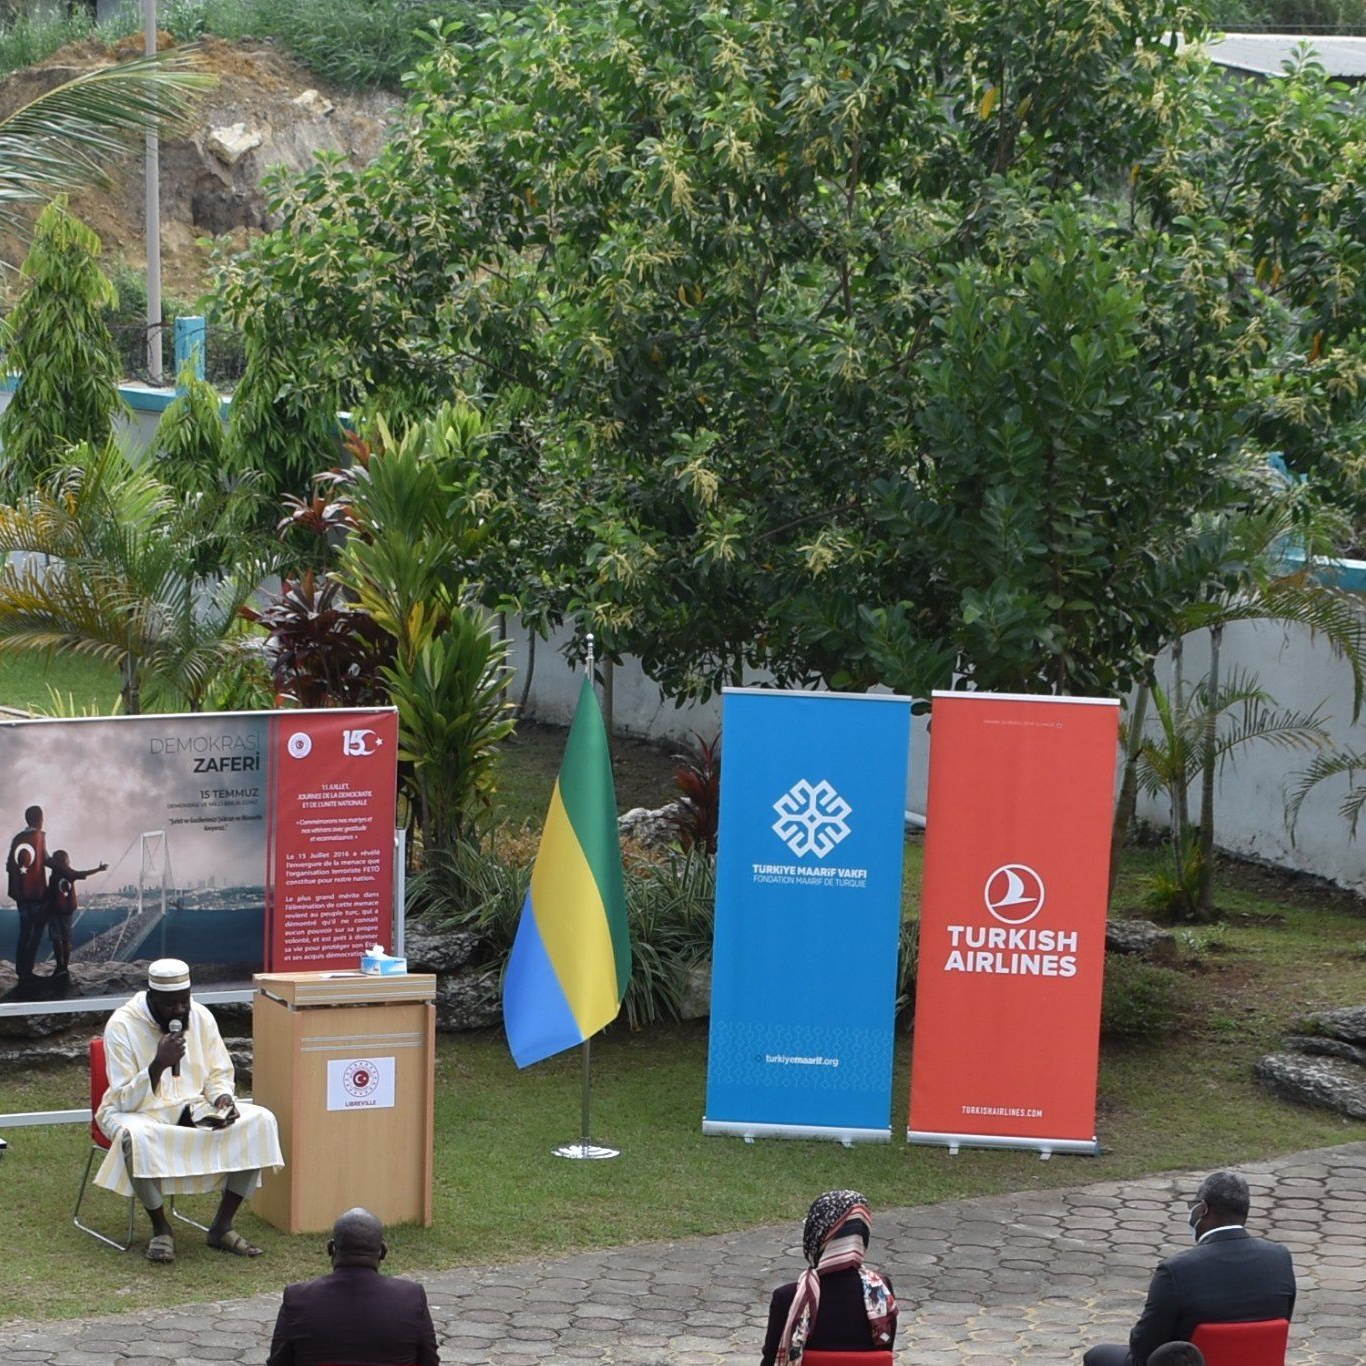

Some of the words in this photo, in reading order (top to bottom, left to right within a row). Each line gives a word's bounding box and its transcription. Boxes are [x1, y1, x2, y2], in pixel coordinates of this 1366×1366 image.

[194, 752, 260, 773] ZAFERİ
[200, 790, 210, 799] 15
[213, 788, 259, 798] TEMMUZ
[286, 869, 330, 877] l'organisation
[332, 867, 361, 875] terroriste
[837, 868, 867, 879] VAKFI
[754, 875, 794, 884] FONDATION
[824, 878, 834, 886] DE
[835, 879, 867, 888] TURQUIE
[315, 894, 334, 902] grand
[321, 910, 343, 918] peuple
[947, 925, 1077, 952] TURKISH
[322, 944, 350, 952] protéger
[944, 950, 1077, 977] AIRLINES
[766, 1054, 839, 1067] turkiyemaarif.org
[962, 1106, 1043, 1117] TURKISHAIRLINES.COM
